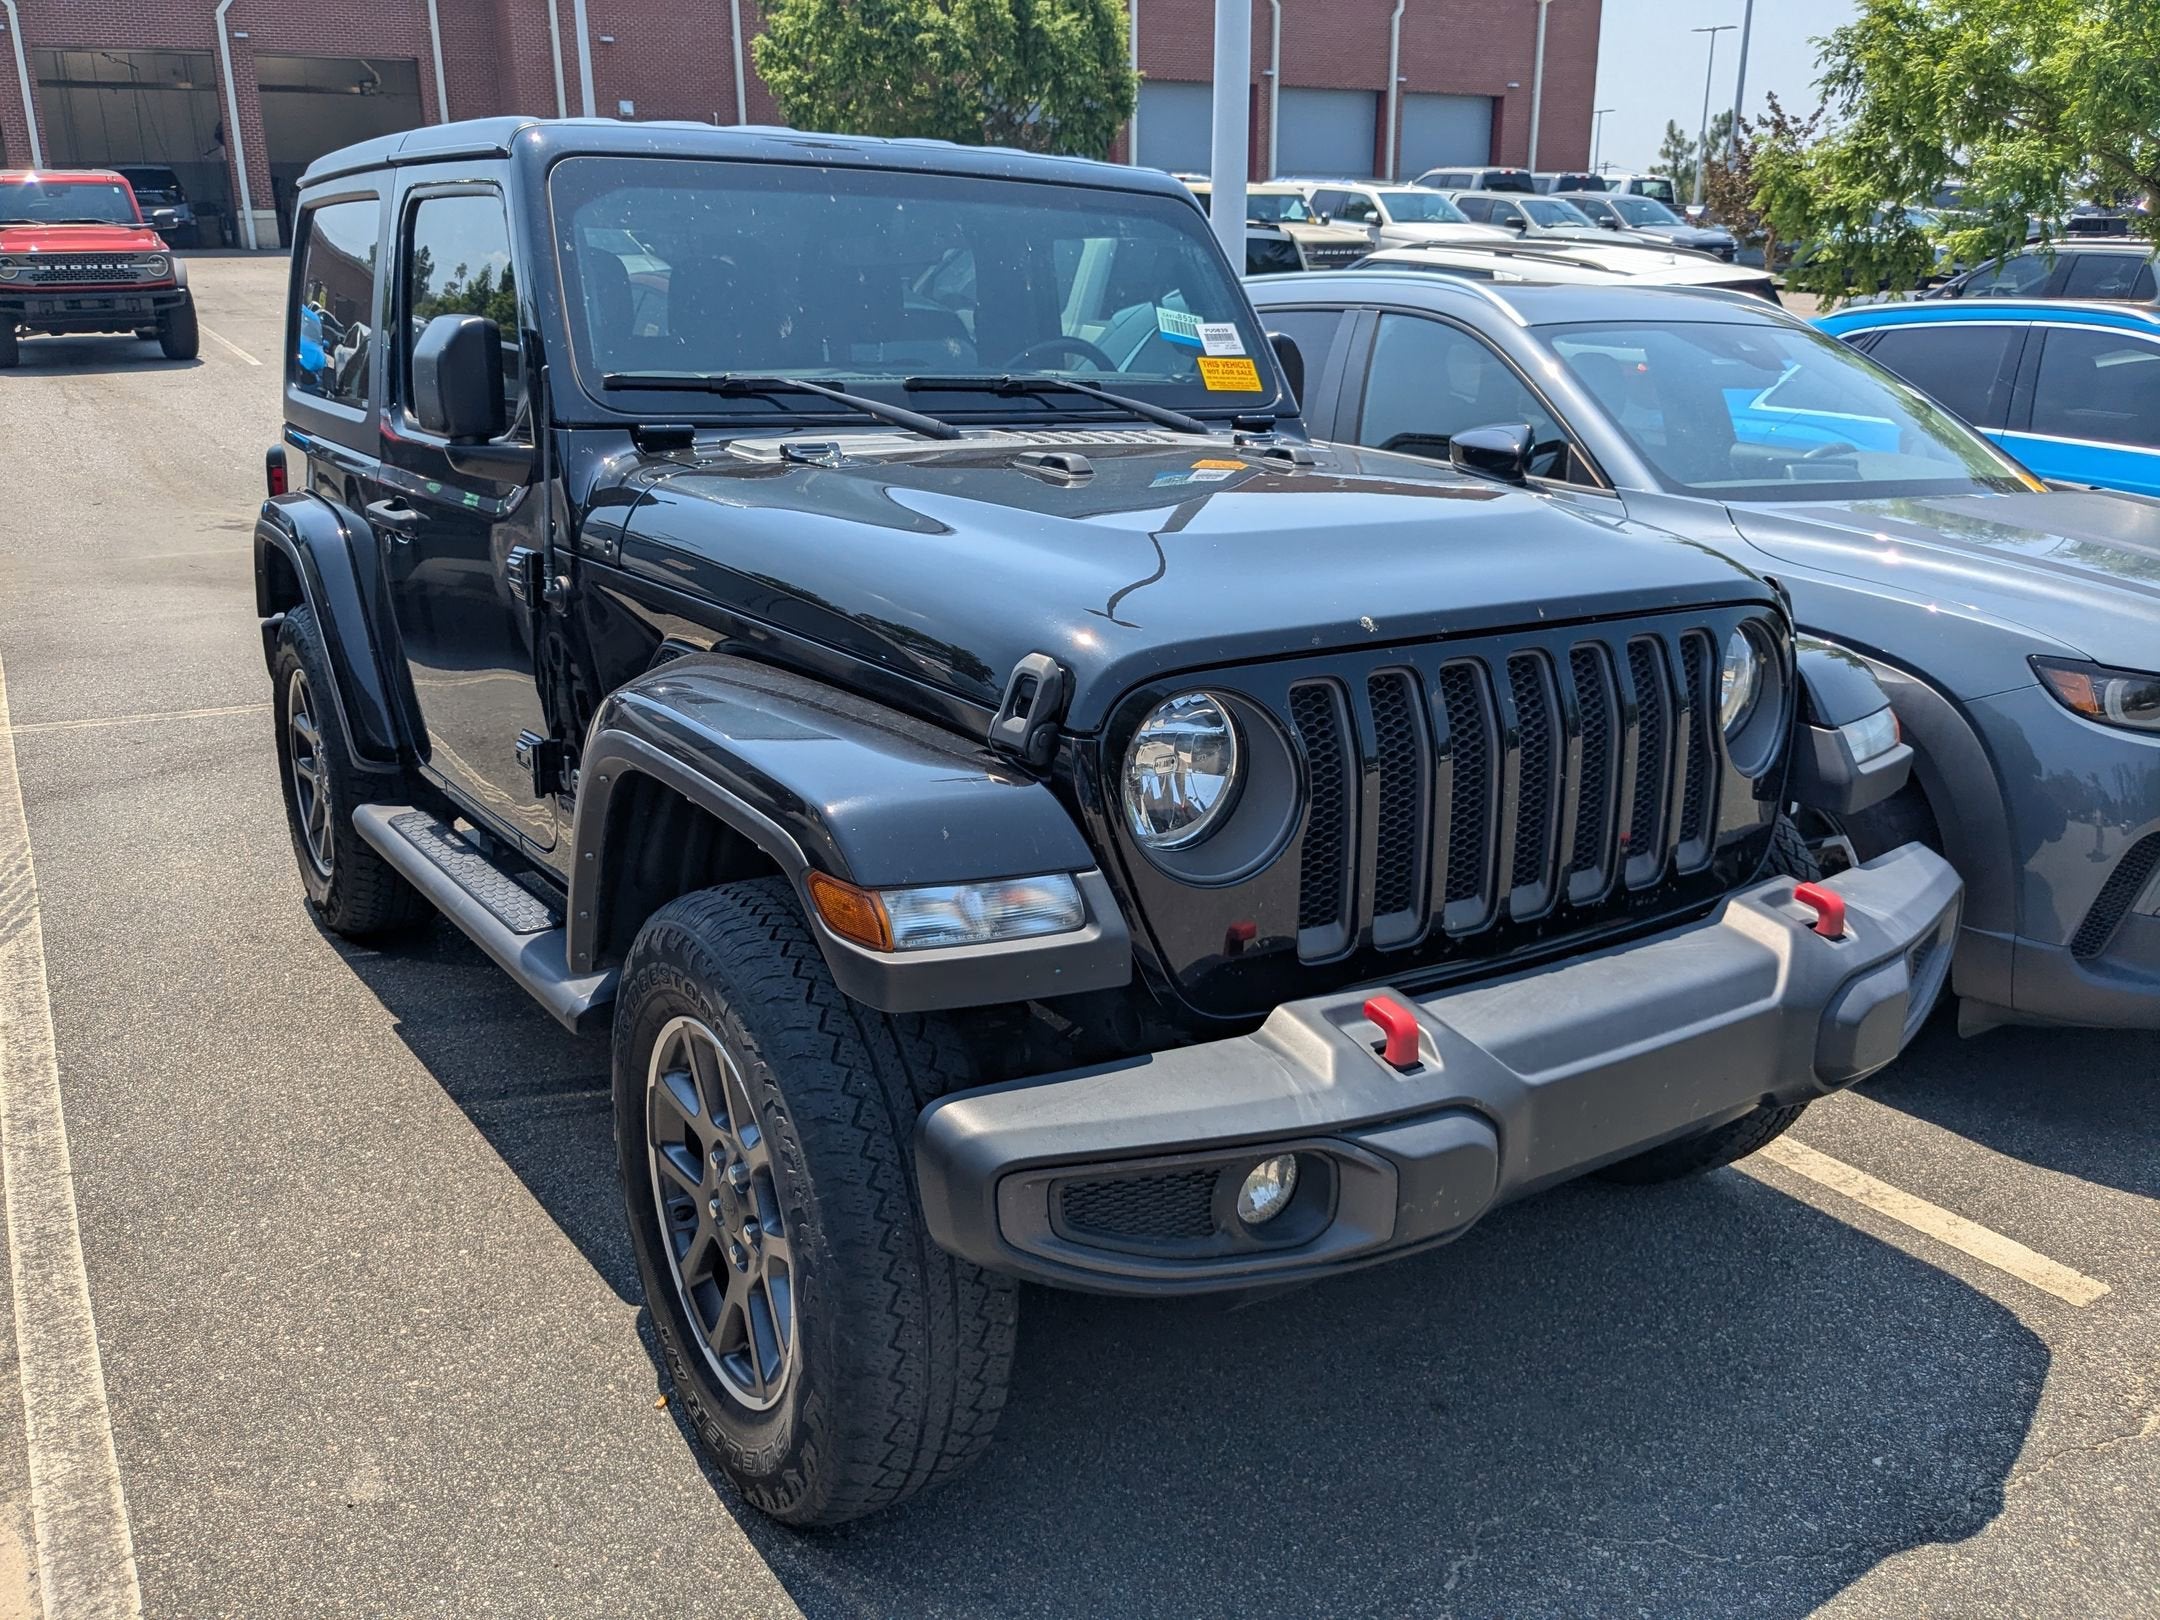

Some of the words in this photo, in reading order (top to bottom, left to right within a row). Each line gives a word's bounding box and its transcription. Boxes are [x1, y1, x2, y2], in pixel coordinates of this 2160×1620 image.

[1202, 360, 1220, 369] THIS
[1222, 360, 1252, 370] VEHICLE
[1206, 368, 1220, 376] NOT
[1236, 369, 1253, 377] SALE
[657, 1321, 689, 1381] A/T
[687, 1390, 791, 1475] DUELER
